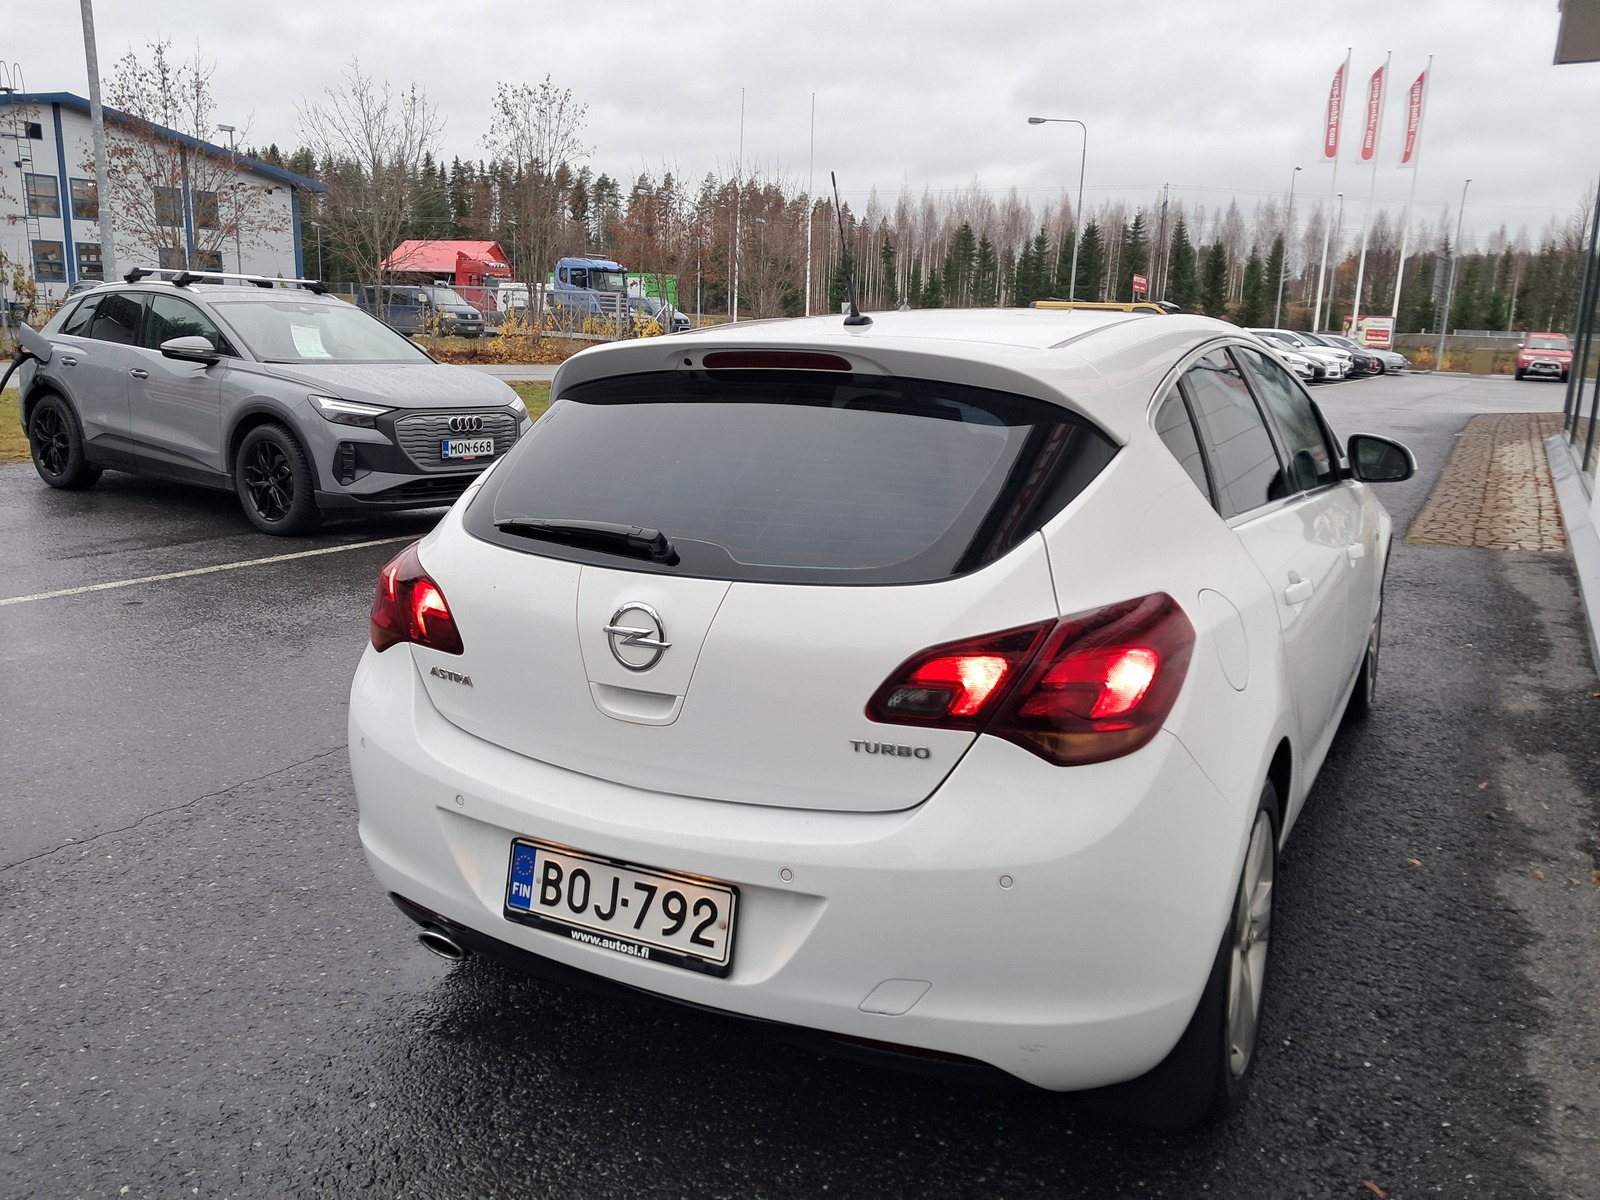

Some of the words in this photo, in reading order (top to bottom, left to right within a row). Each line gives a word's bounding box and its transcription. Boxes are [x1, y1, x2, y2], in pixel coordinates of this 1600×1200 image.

[450, 442, 492, 454] MON-668
[430, 666, 473, 688] ASTRA
[849, 738, 930, 759] TURBO
[512, 881, 531, 899] FIN
[540, 860, 718, 948] BOJ-792
[571, 929, 650, 959] www.autosi.fi
